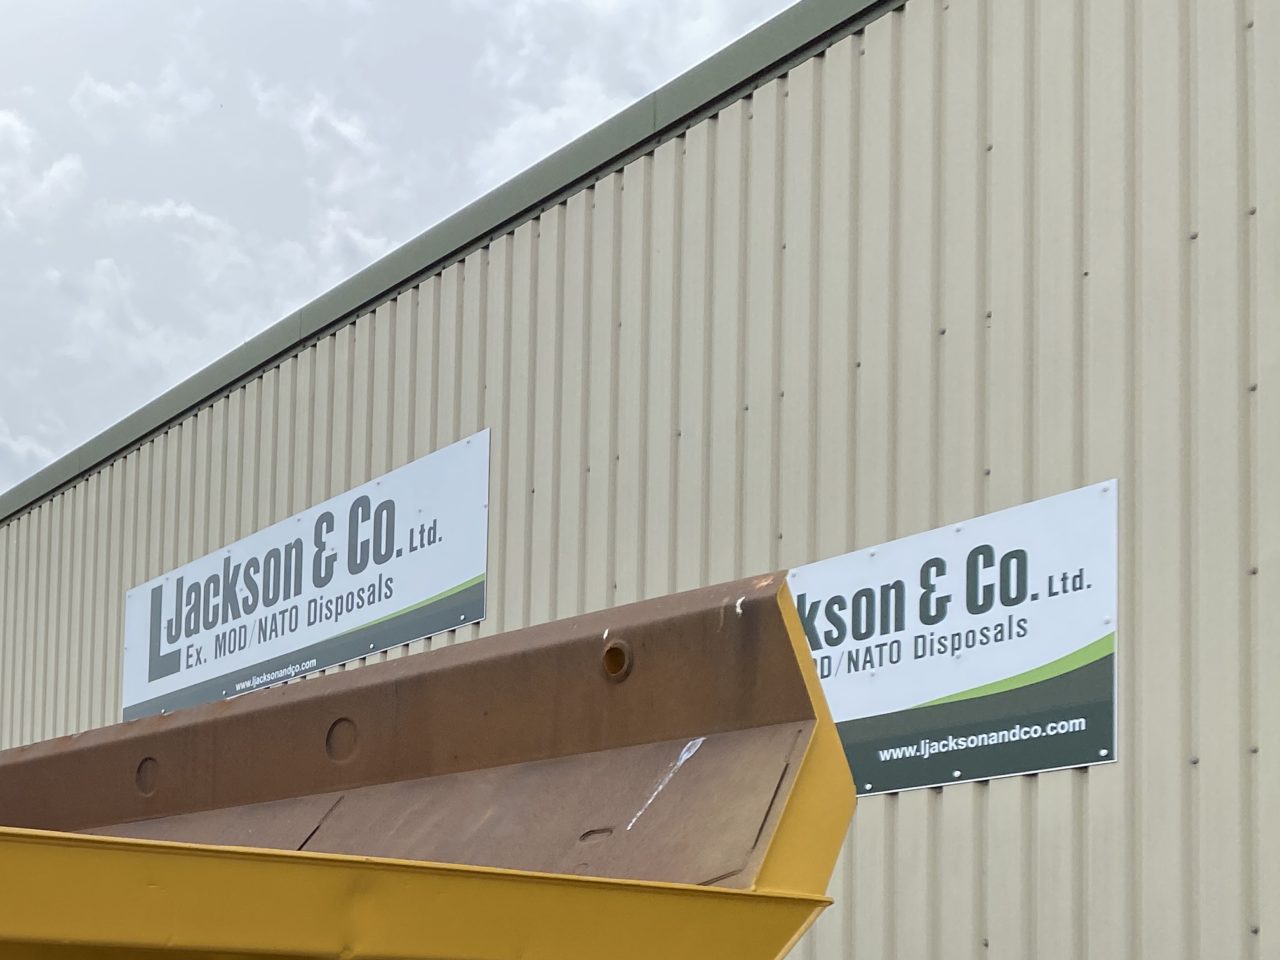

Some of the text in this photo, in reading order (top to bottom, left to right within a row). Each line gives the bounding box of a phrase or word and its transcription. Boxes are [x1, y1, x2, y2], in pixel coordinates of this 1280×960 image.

[312, 511, 337, 589] &
[347, 495, 403, 576] Co.
[409, 518, 443, 553] Ltd.
[185, 573, 394, 670] Ex. MOD/NATO Disposals
[797, 544, 1092, 652] kson & Co. Ltd.
[235, 658, 317, 692] www.ljacksonandco.com
[812, 614, 1029, 679] D/NATO Disposals
[878, 717, 1087, 762] www.ljacksonandco.com
